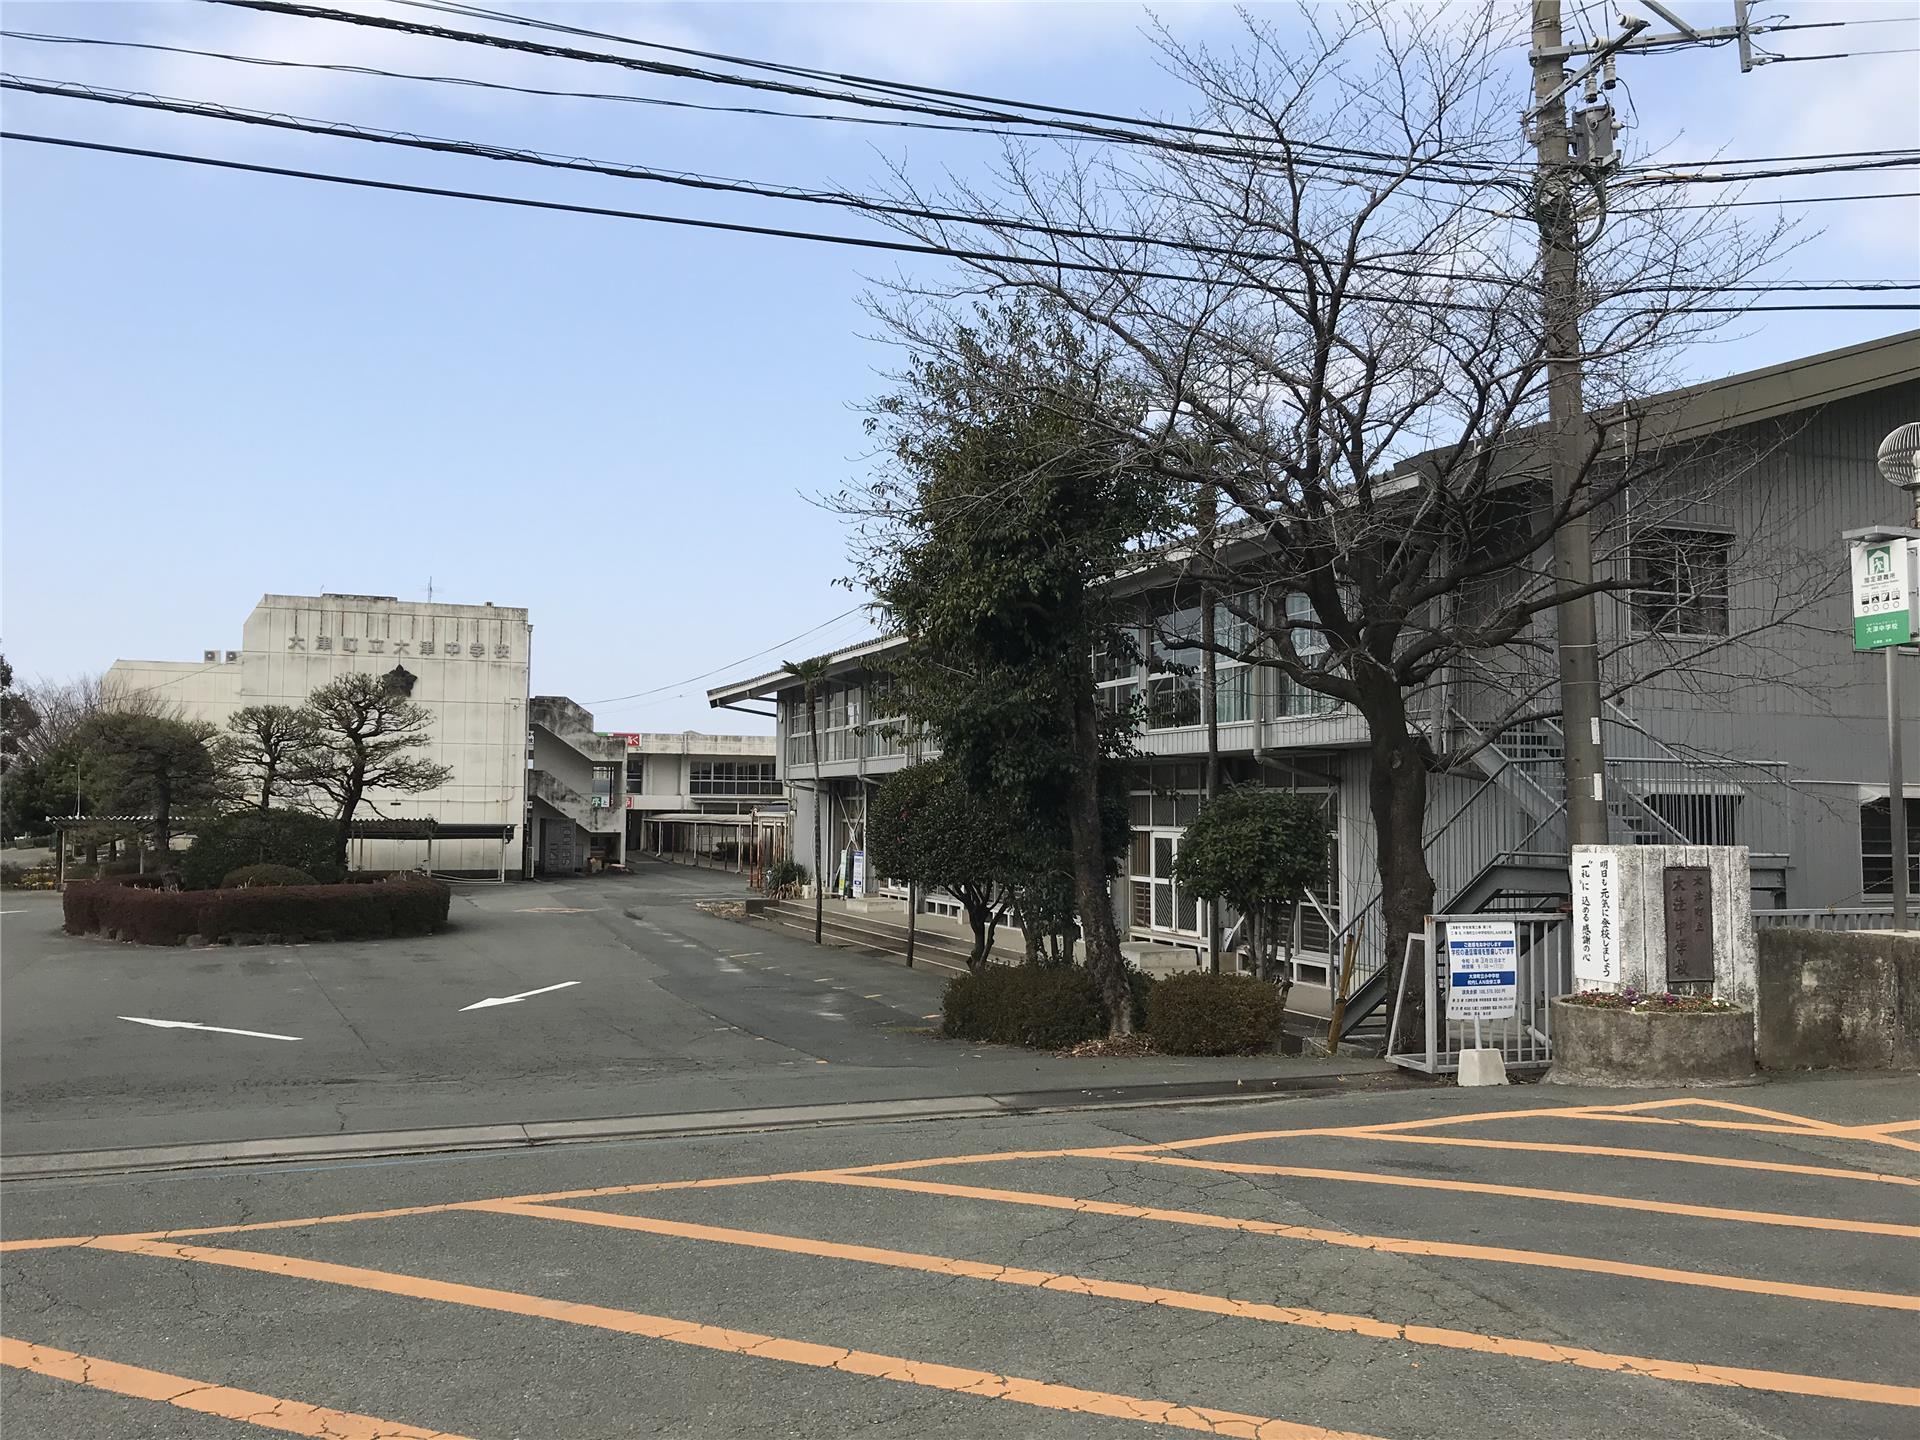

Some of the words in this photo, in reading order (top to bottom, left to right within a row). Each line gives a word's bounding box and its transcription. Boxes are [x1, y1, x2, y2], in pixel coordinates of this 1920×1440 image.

[1866, 623, 1898, 633] 大津中学校
[287, 634, 510, 659] 大津町立大津中学校
